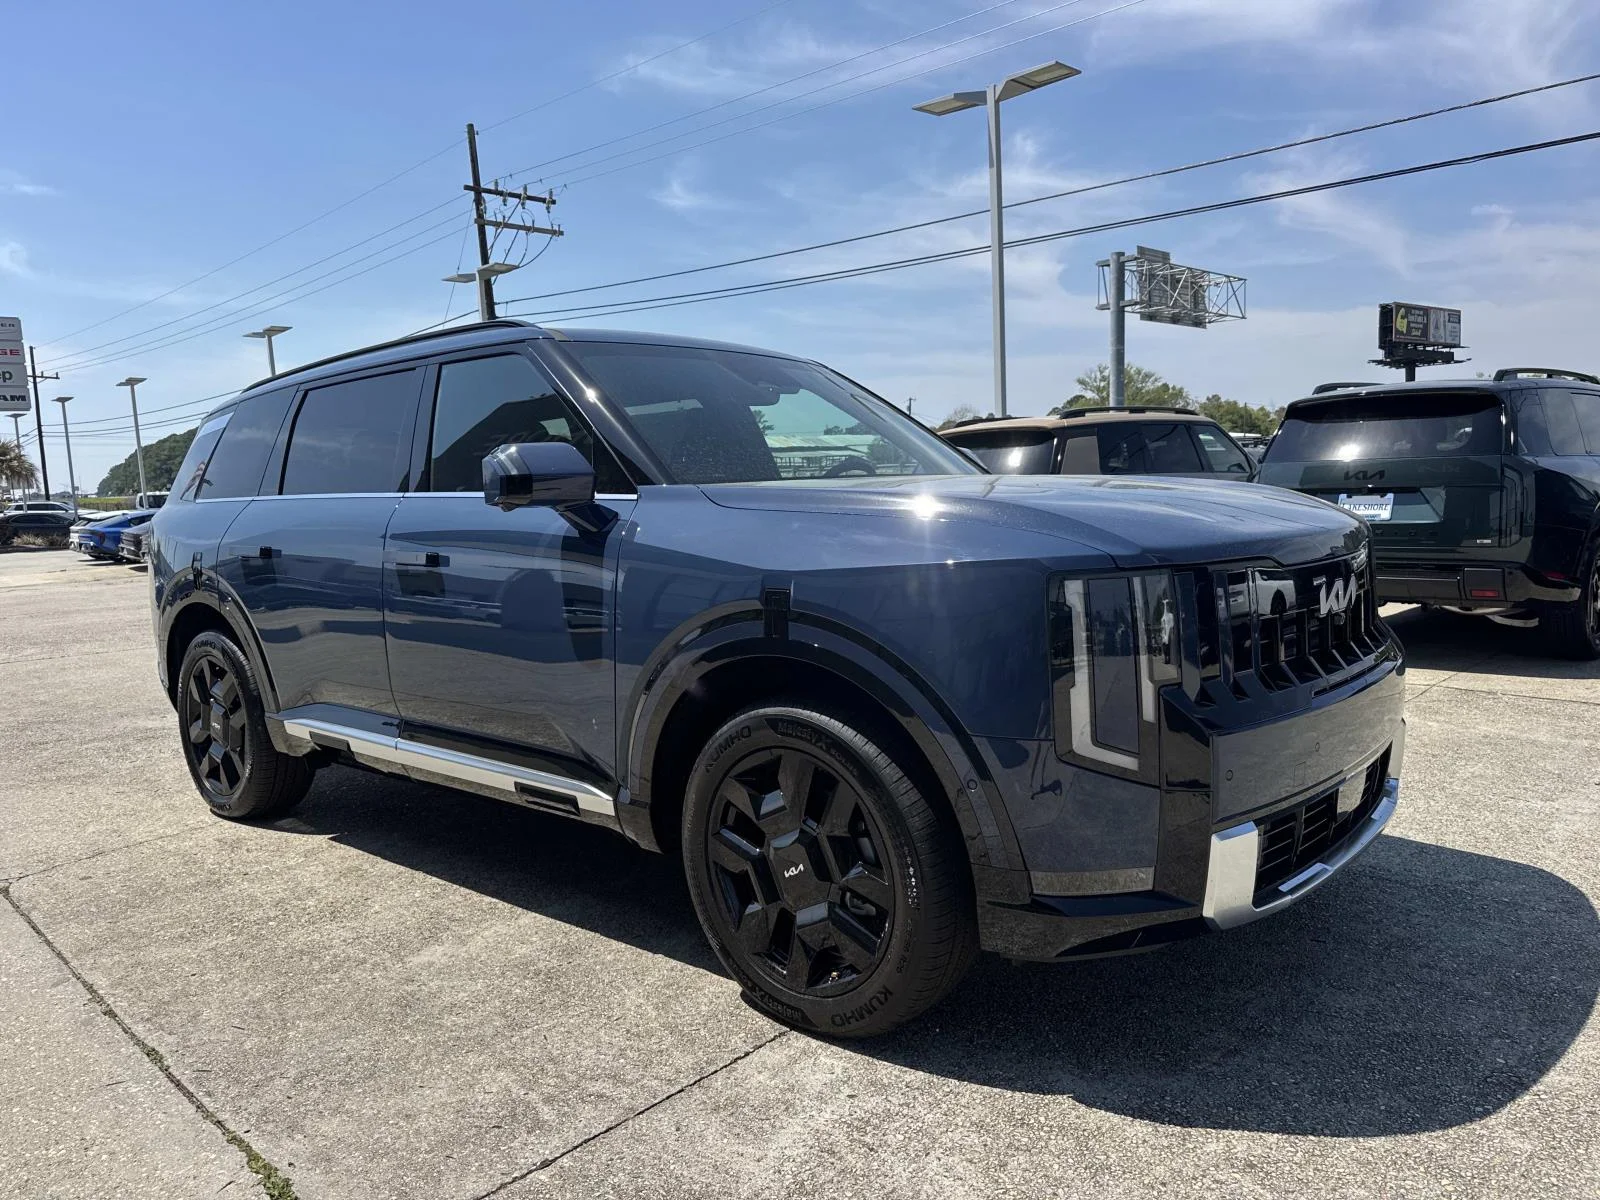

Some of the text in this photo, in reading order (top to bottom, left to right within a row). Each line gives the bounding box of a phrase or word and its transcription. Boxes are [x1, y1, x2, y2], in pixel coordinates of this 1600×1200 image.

[1344, 470, 1385, 480] KIA
[1319, 573, 1357, 616] KIA
[784, 863, 804, 878] KIA
[831, 984, 893, 1027] KUMHO
